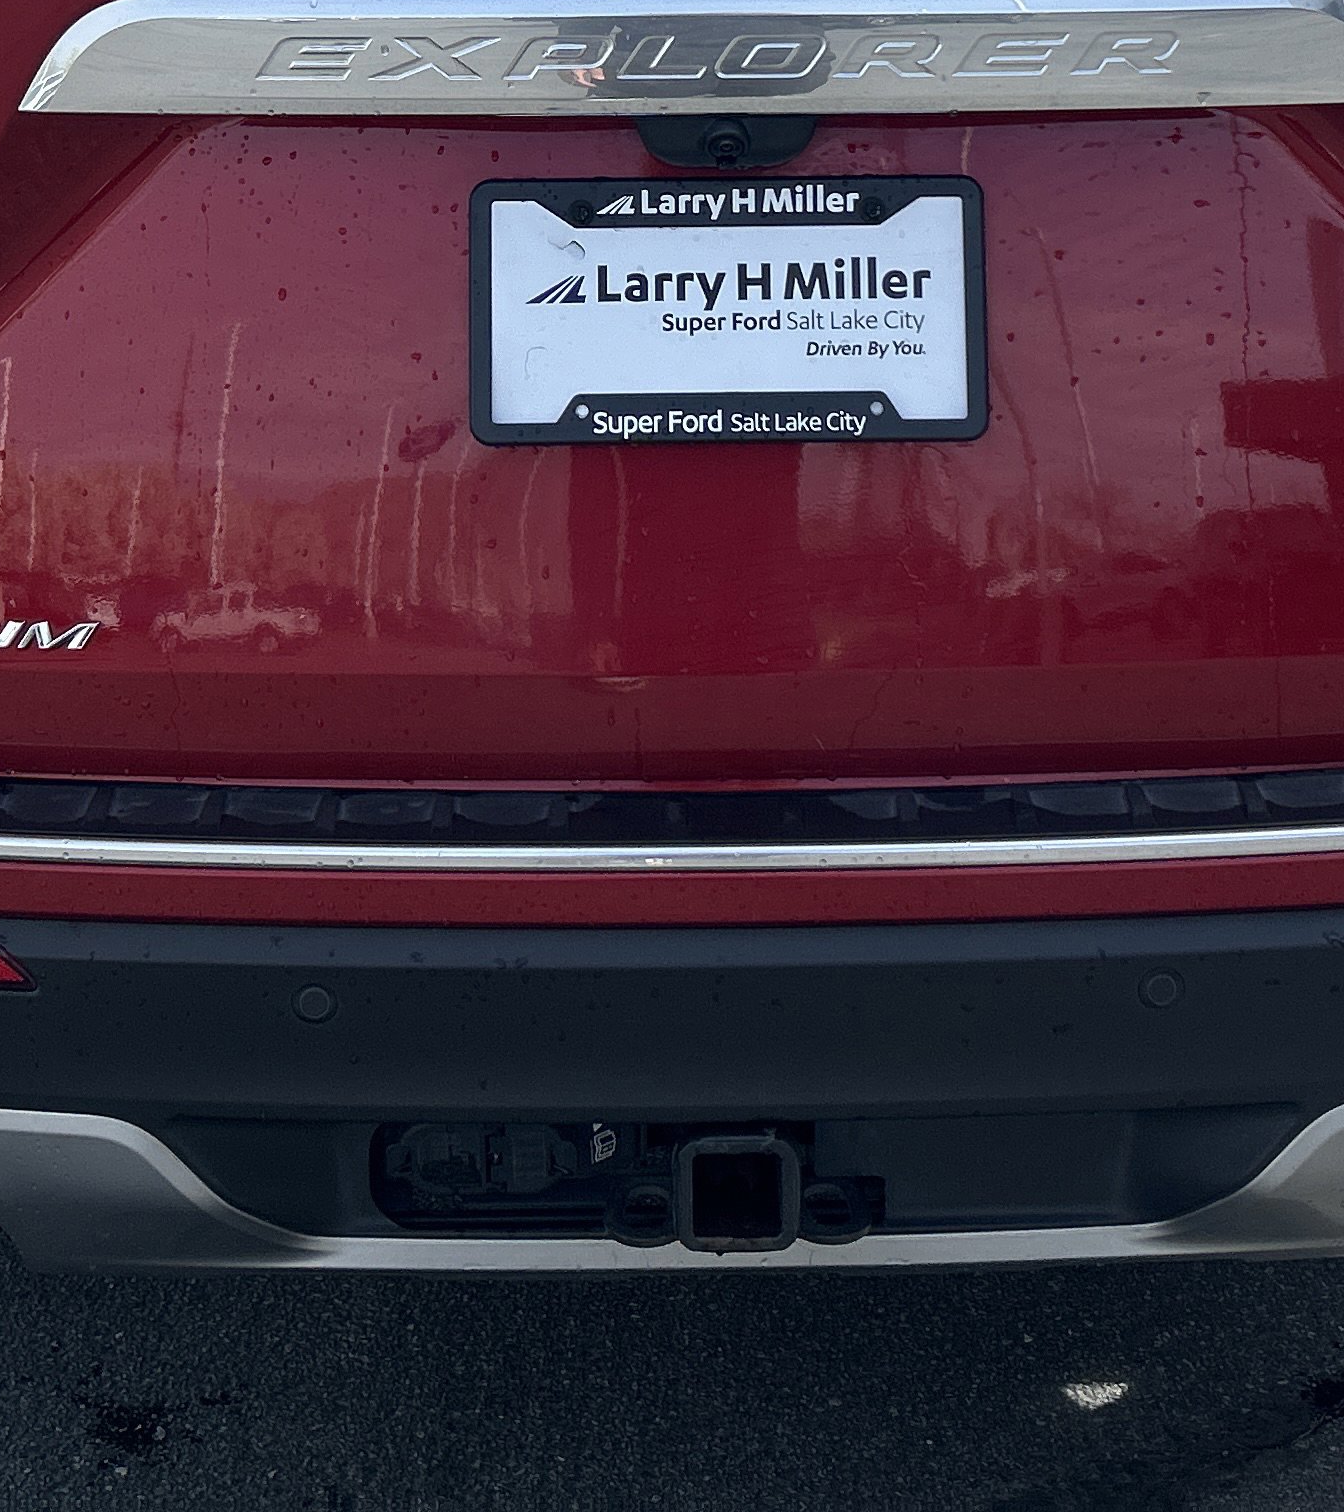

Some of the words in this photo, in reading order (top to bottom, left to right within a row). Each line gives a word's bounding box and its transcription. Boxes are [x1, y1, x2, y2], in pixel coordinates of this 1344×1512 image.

[256, 31, 1182, 83] EXPLORER
[641, 189, 725, 220] Larry
[732, 190, 756, 213] H
[763, 185, 859, 213] Miller
[597, 265, 725, 311] Larry
[737, 264, 772, 300] H
[784, 257, 932, 300] Miller
[662, 313, 726, 336] Super
[732, 311, 781, 330] Ford
[787, 311, 825, 330] Salt
[831, 311, 878, 329] Lake
[885, 310, 925, 334] City
[806, 341, 863, 356] Driven
[867, 341, 889, 359] By
[593, 412, 663, 438] Super
[669, 410, 722, 432] Ford
[730, 413, 771, 432] Salt
[775, 411, 822, 432] Lake
[827, 410, 866, 435] City
